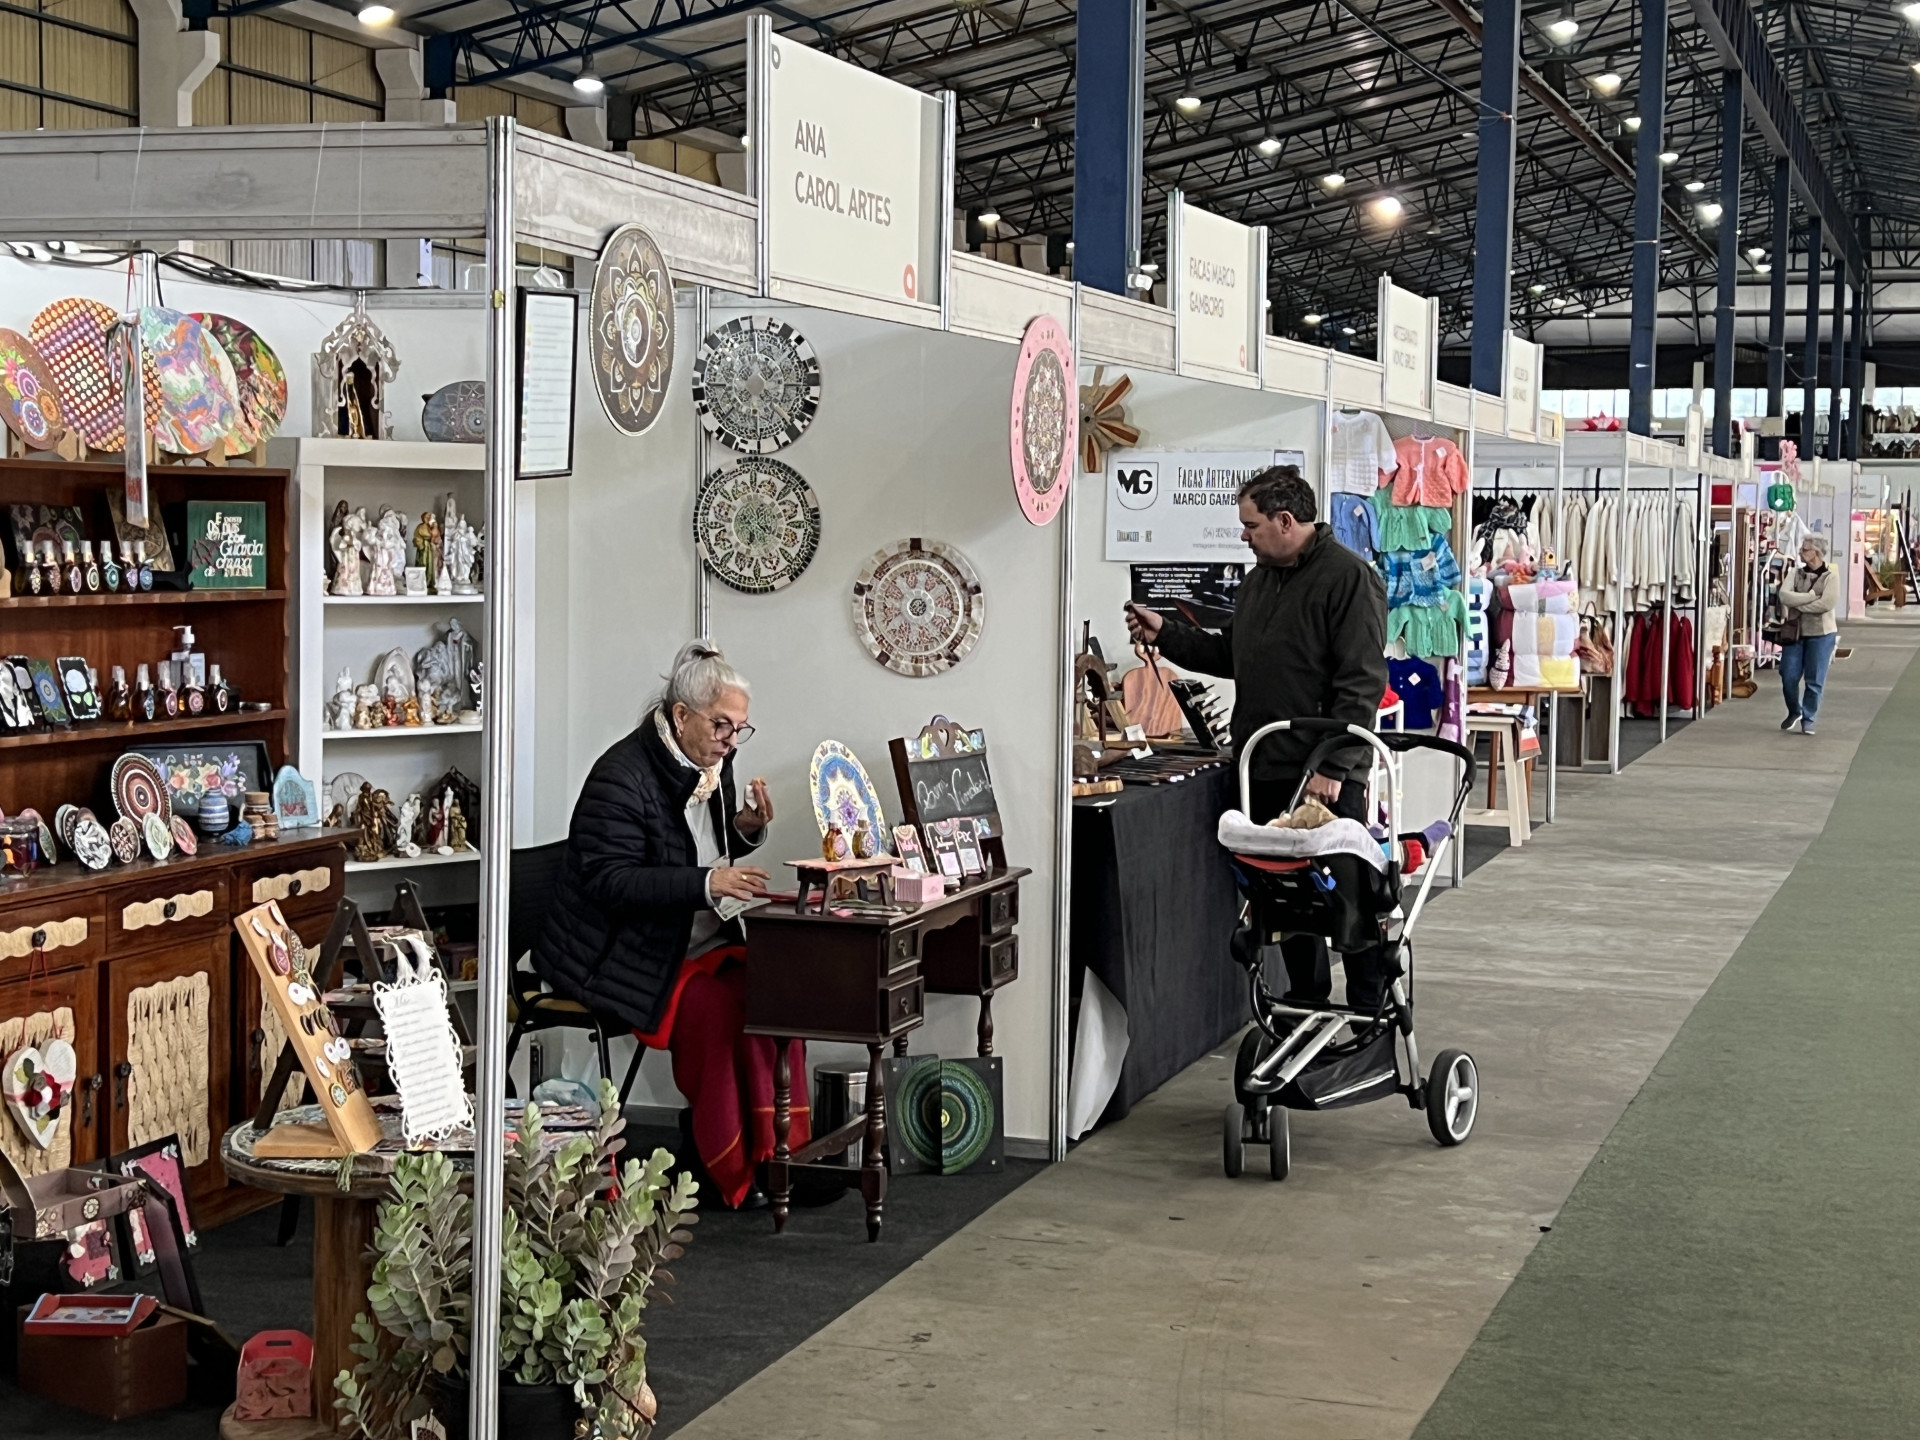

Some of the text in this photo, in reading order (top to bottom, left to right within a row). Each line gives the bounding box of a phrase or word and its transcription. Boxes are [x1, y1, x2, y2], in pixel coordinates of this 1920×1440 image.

[794, 119, 827, 158] ANA
[794, 171, 891, 227] CAROL ARTES
[1189, 256, 1236, 289] FACAS MARCO
[1189, 291, 1225, 319] GAMBORGI
[1117, 469, 1153, 494] MG
[1172, 492, 1238, 506] MARCO GAMB
